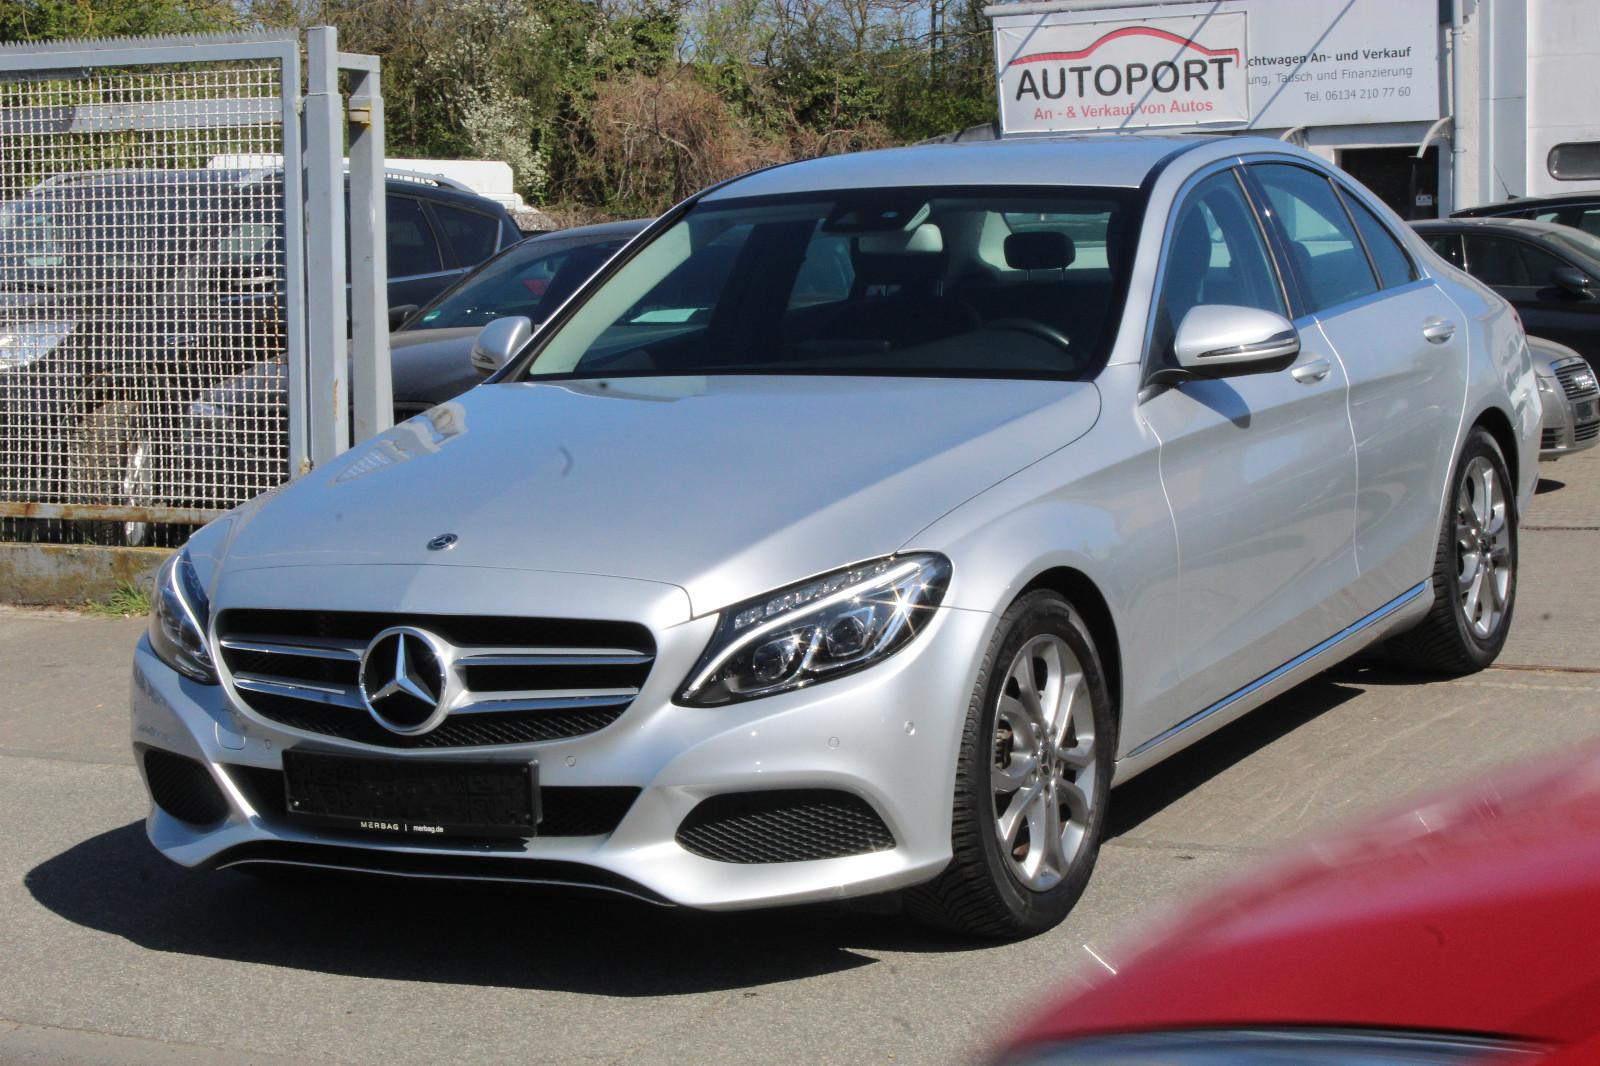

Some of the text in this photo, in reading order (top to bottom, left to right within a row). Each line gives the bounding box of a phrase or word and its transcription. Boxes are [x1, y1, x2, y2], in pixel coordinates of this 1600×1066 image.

[1248, 55, 1307, 67] chtwagen
[1335, 50, 1358, 61] und
[1362, 46, 1412, 60] Verkauf
[1015, 57, 1233, 101] AUTOPORT
[1276, 72, 1312, 83] Tausch
[1317, 69, 1337, 81] und
[1342, 67, 1413, 79] Finanzierung
[1304, 86, 1411, 102] Tel. 06134 210 77 60
[1034, 107, 1053, 120] An
[1066, 106, 1077, 119] &
[1081, 102, 1136, 118] Verkauf
[1140, 103, 1166, 114] von
[1170, 100, 1213, 113] Autos
[360, 821, 443, 833] MERBAG merbag.de
